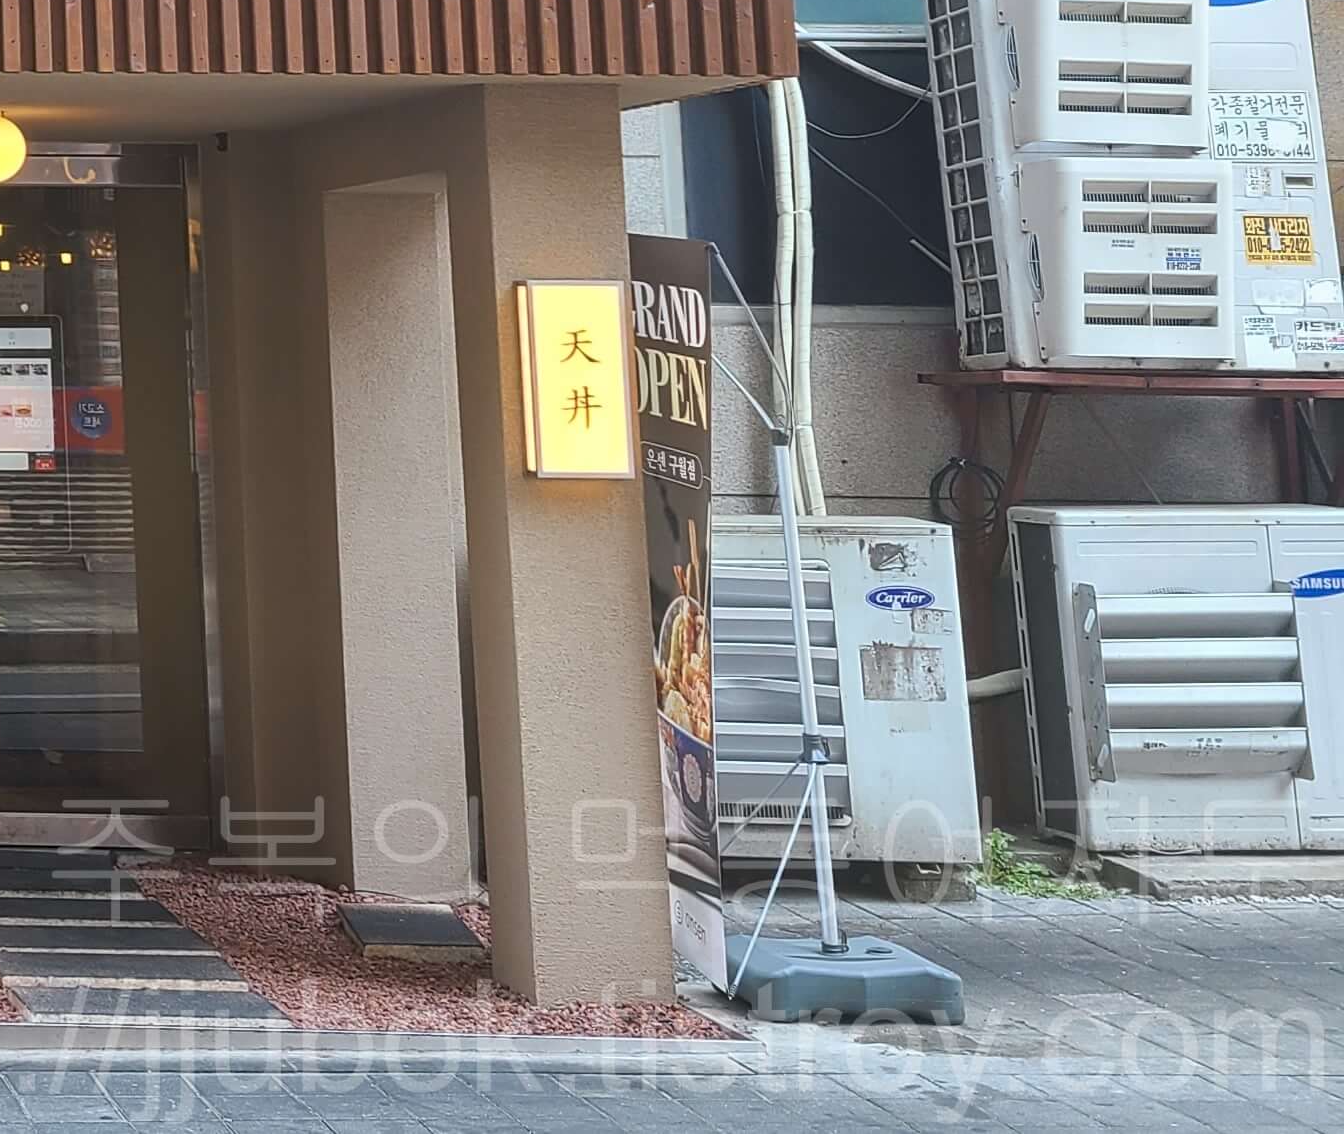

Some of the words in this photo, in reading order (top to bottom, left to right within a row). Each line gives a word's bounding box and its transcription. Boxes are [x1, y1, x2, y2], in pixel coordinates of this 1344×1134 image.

[632, 280, 706, 348] RAND
[560, 329, 604, 430] 天丼
[875, 591, 926, 604] Carrier
